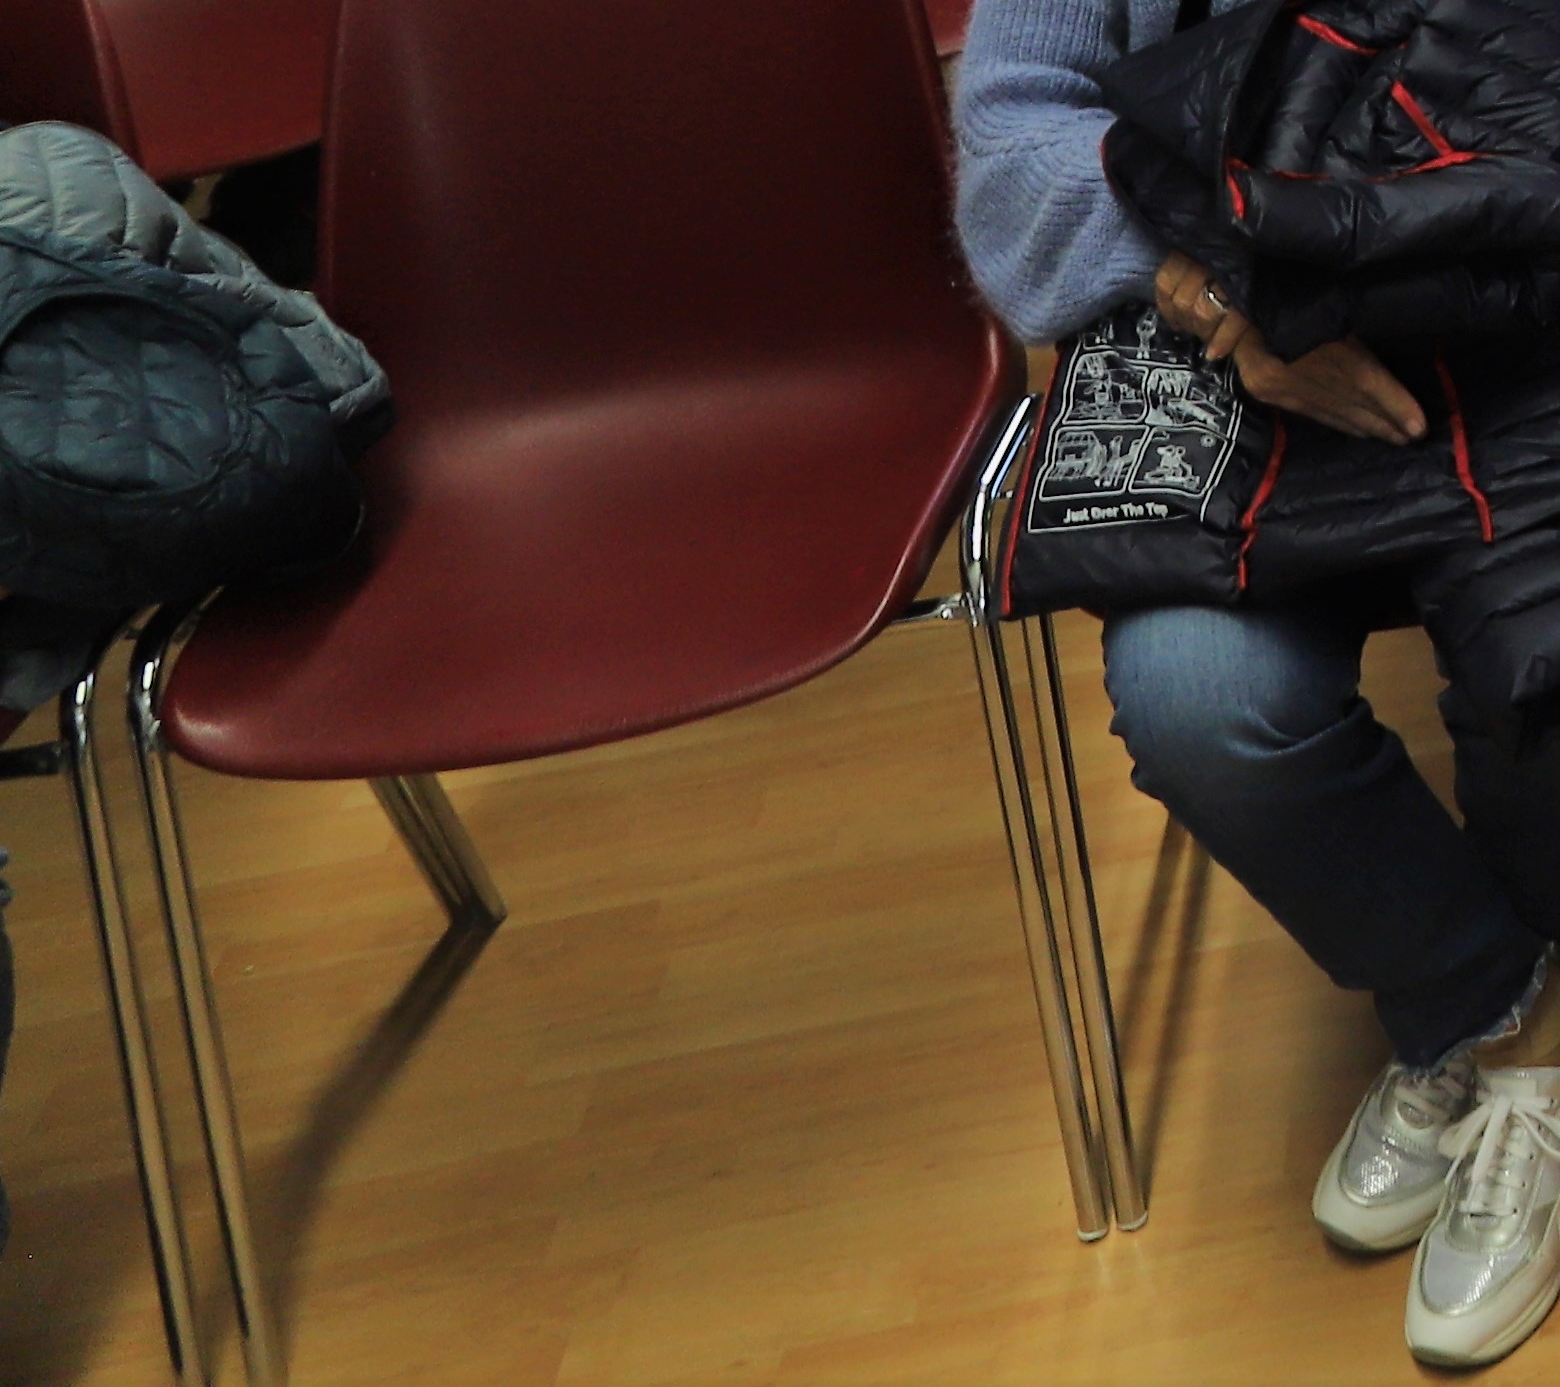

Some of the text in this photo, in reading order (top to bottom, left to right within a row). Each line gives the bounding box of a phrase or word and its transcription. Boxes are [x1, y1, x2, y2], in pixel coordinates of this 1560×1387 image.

[1063, 502, 1168, 523] Just Over The Top
